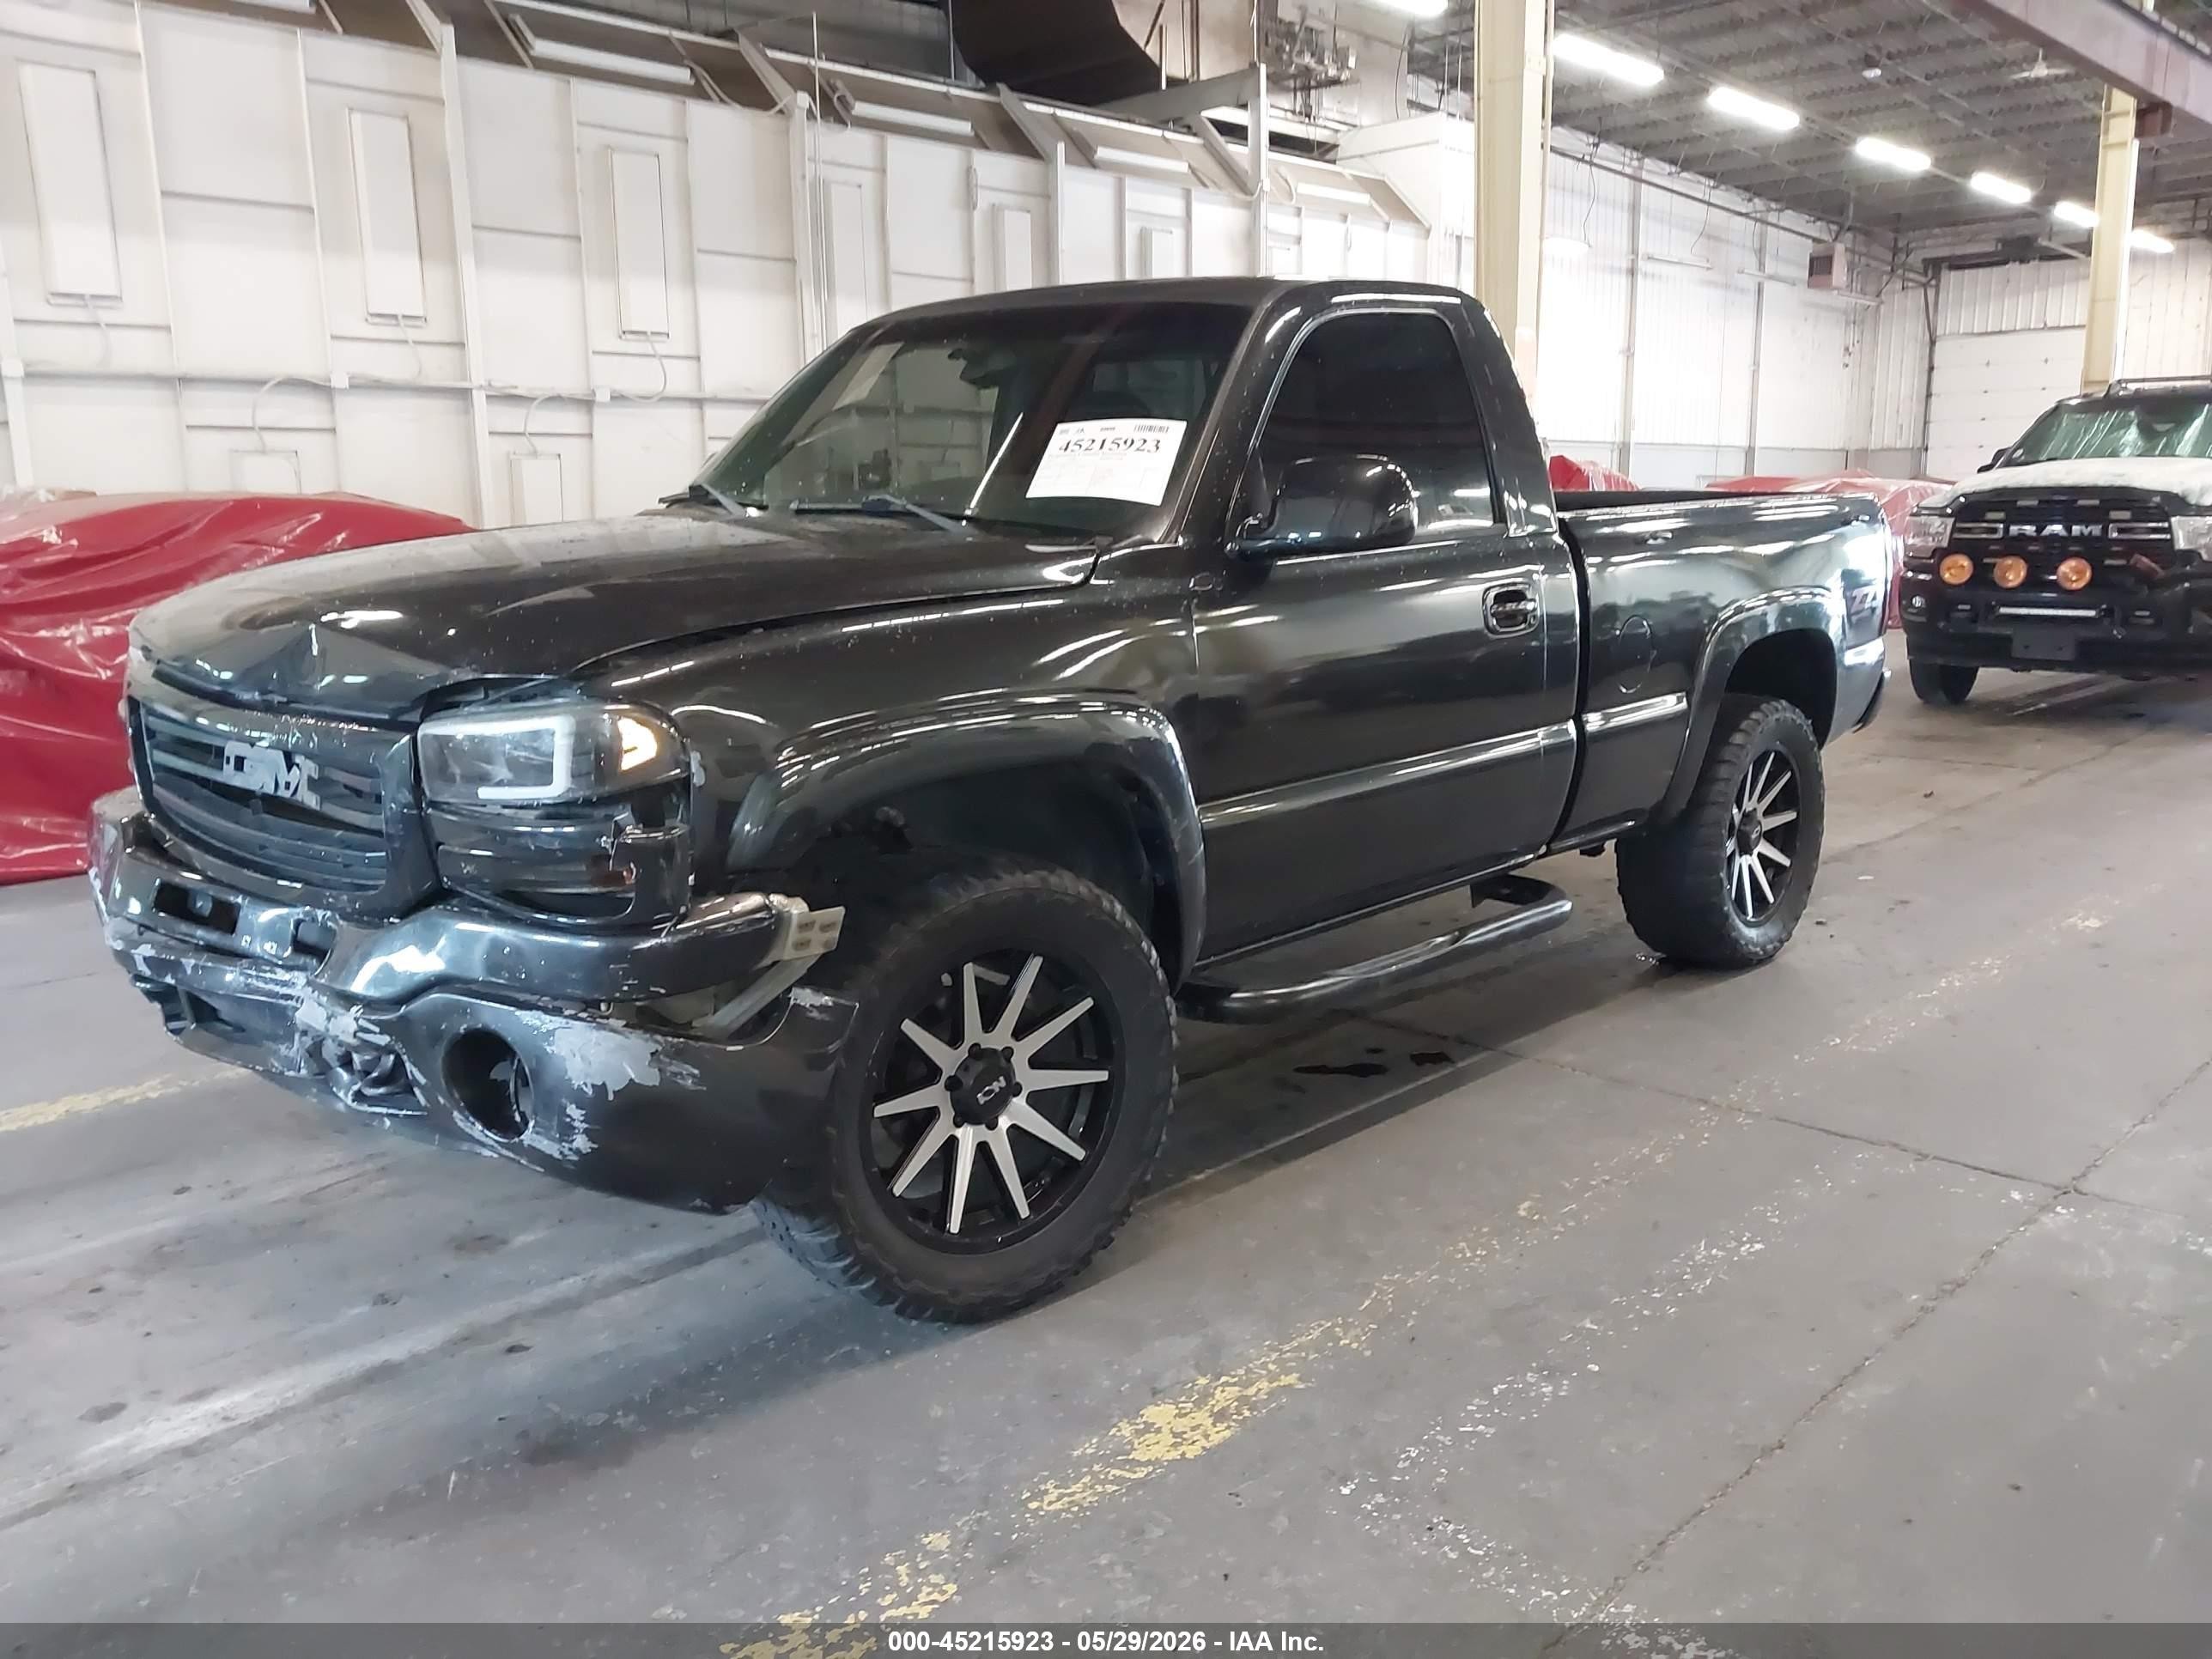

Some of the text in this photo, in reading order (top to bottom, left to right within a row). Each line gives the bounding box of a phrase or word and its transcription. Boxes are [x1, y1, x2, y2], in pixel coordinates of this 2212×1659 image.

[1059, 437, 1161, 453] 45215923
[2008, 524, 2103, 538] RAM
[976, 1075, 1007, 1105] ION
